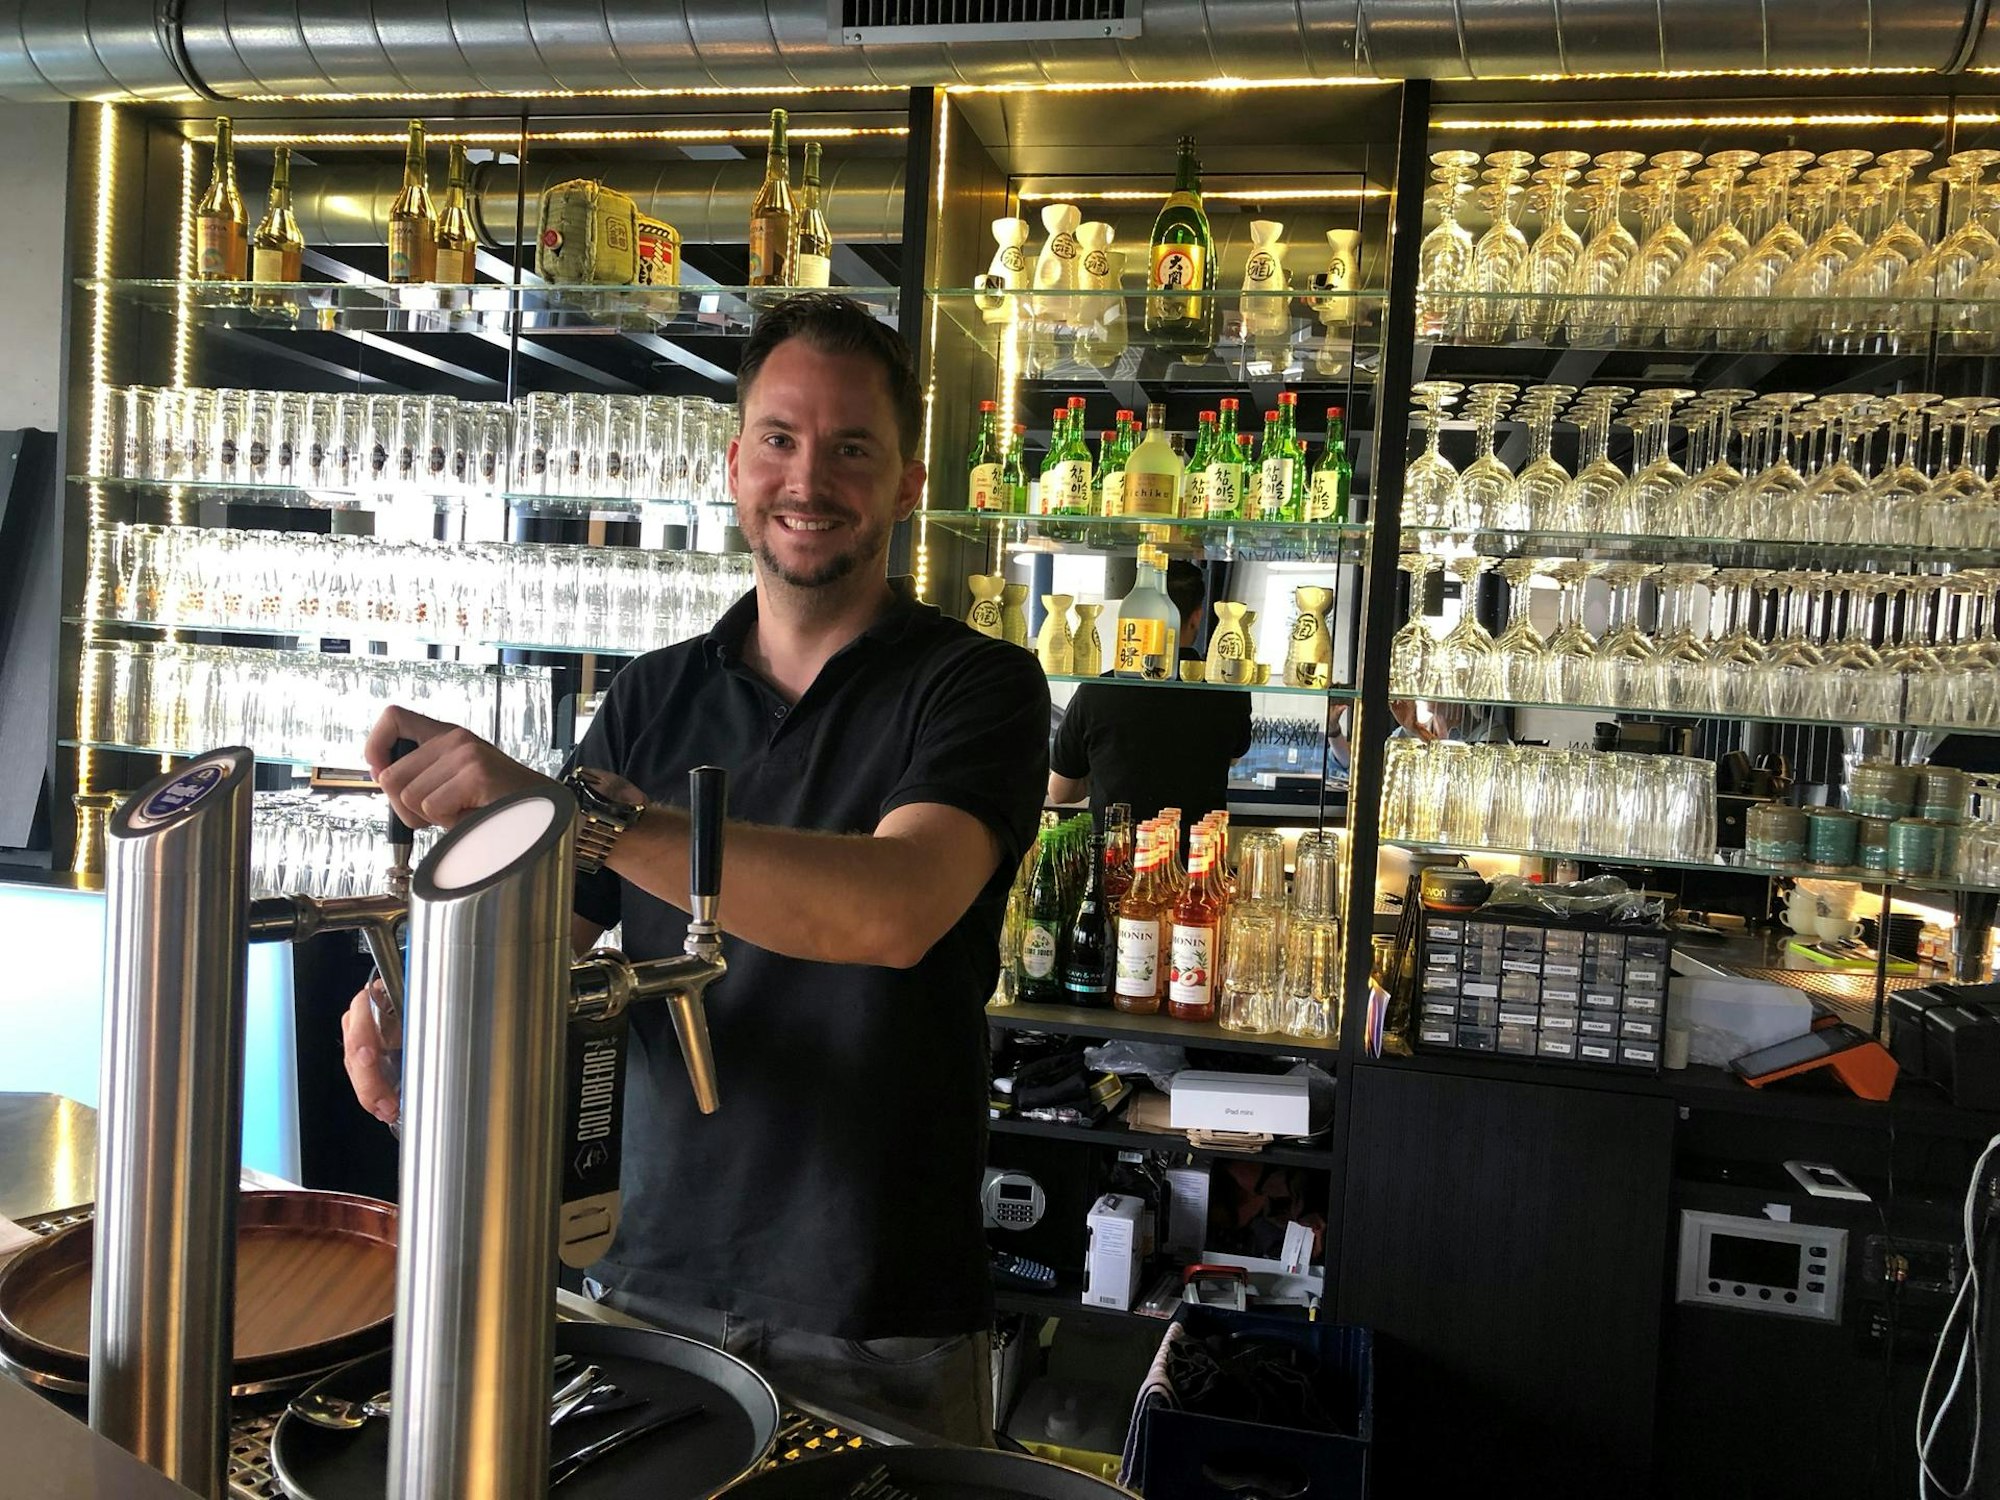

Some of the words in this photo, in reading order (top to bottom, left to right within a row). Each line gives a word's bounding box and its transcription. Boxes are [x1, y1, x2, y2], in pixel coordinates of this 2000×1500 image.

[1070, 464, 1088, 501] 참이슬
[1214, 467, 1235, 504] 참이슬
[577, 1048, 617, 1141] GOLDBERG
